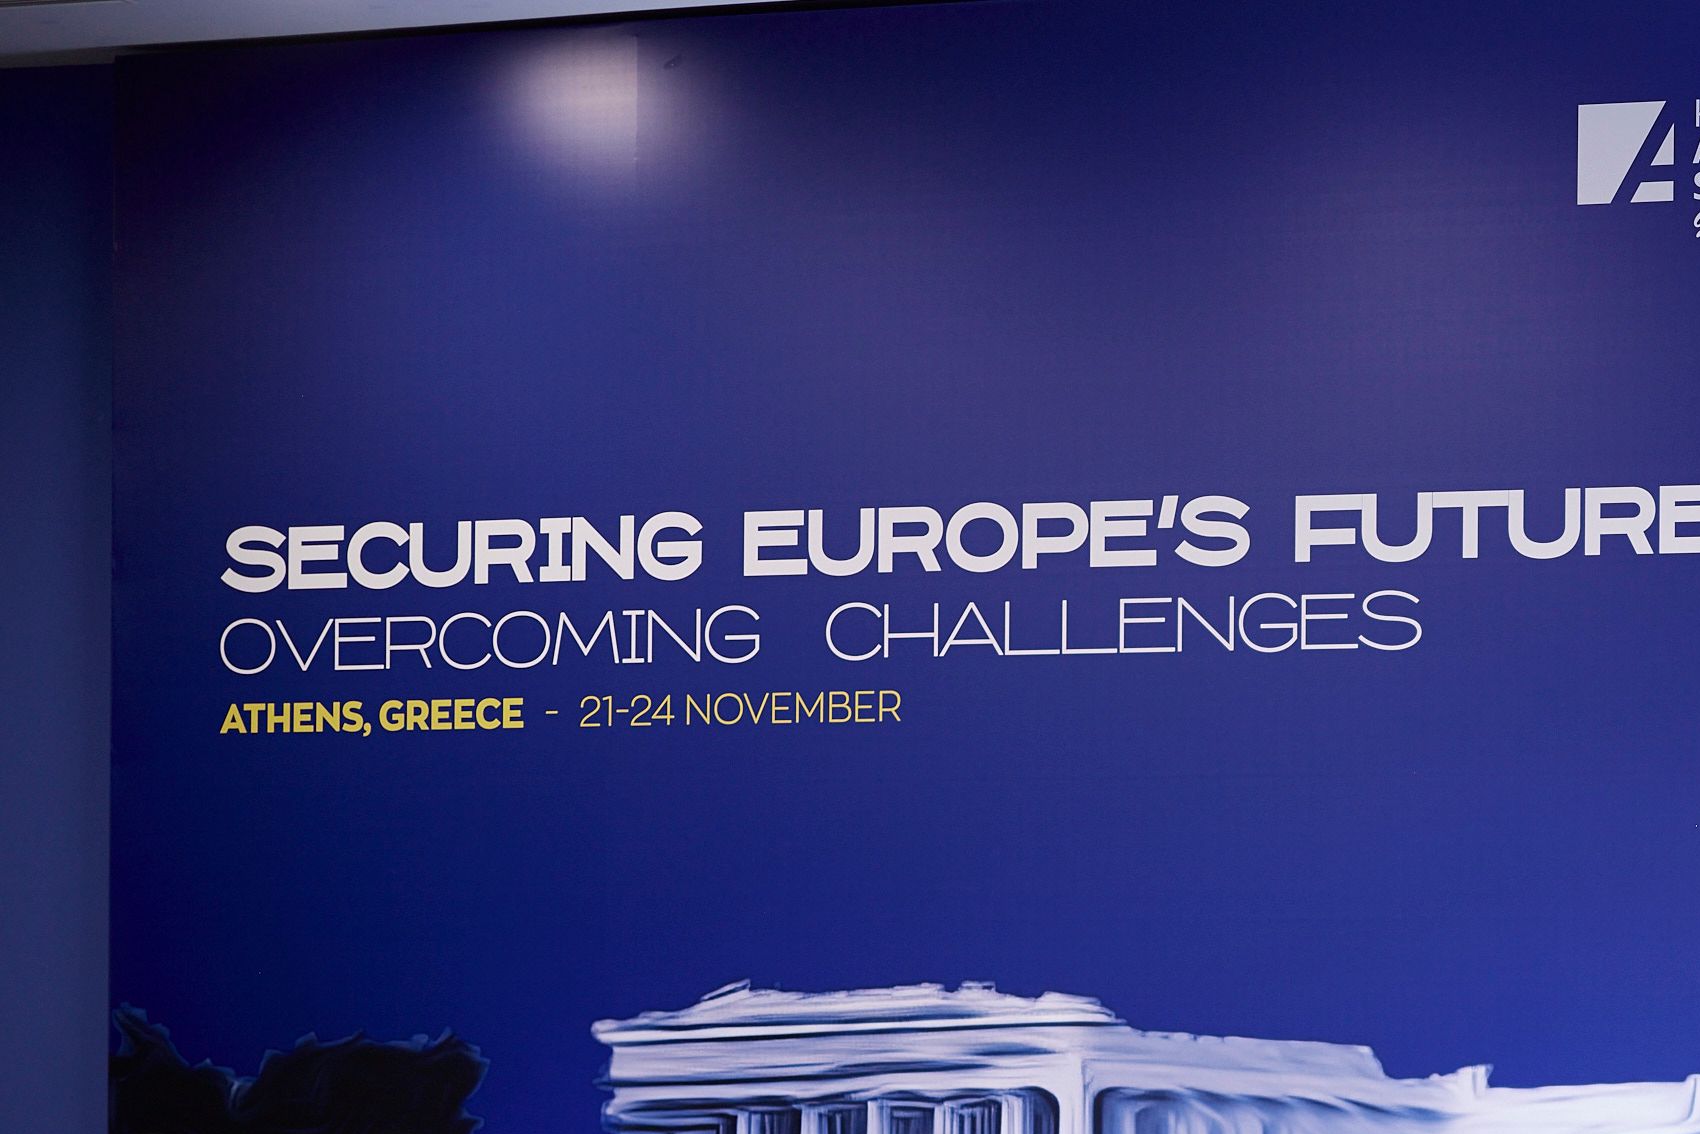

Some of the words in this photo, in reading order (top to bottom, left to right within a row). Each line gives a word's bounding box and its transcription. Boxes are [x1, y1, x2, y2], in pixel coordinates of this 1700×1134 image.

[220, 511, 704, 593] SECURING
[743, 494, 1251, 577] EUROPE'S
[219, 604, 760, 675] OVERCOMING
[825, 589, 1423, 662] CHALLENGES
[219, 700, 372, 737] ATHENS,
[378, 697, 525, 732] GREECE
[579, 694, 675, 728] 21-24
[686, 690, 901, 726] NOVEMBER
